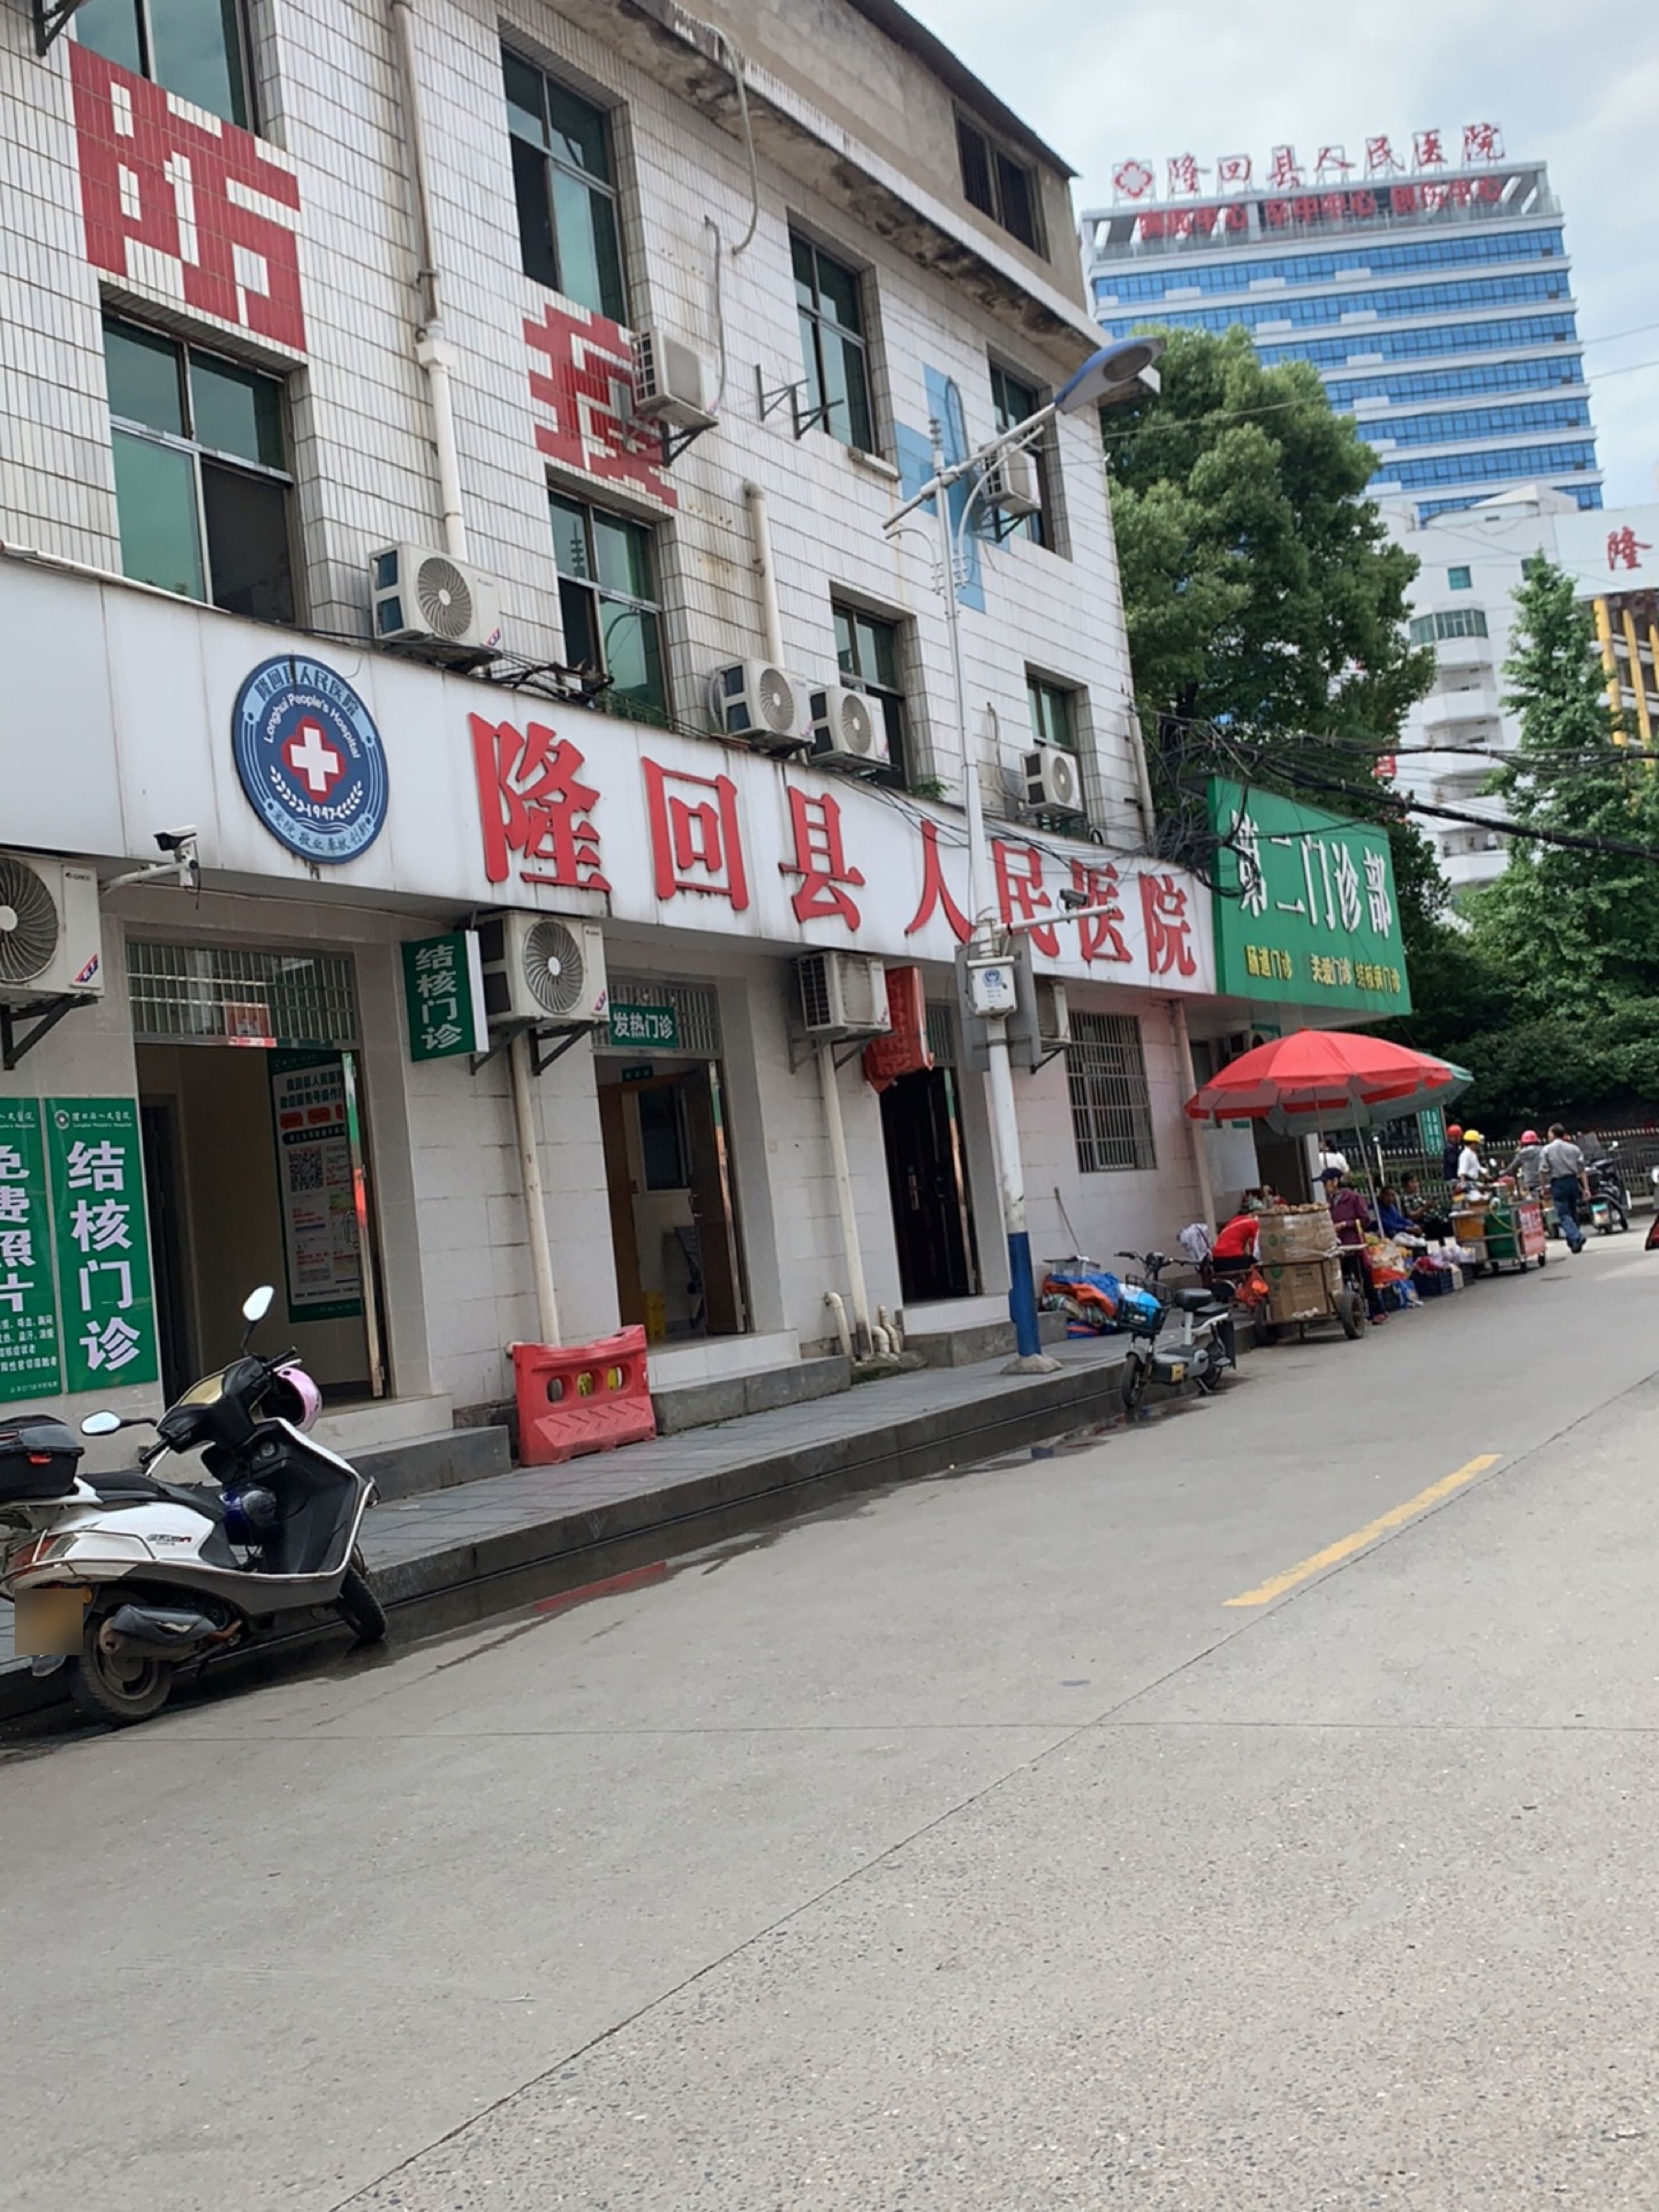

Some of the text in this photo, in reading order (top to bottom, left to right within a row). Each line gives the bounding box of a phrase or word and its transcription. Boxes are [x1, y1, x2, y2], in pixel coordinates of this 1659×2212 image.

[1167, 123, 1505, 193] 隆回县人民医院
[469, 712, 1197, 978] 隆回县人民医院
[1231, 808, 1393, 939] 第二门诊部
[415, 943, 462, 1050] 结核门诊
[613, 1011, 674, 1039] 发热门诊
[67, 1140, 141, 1372] 结核门诊
